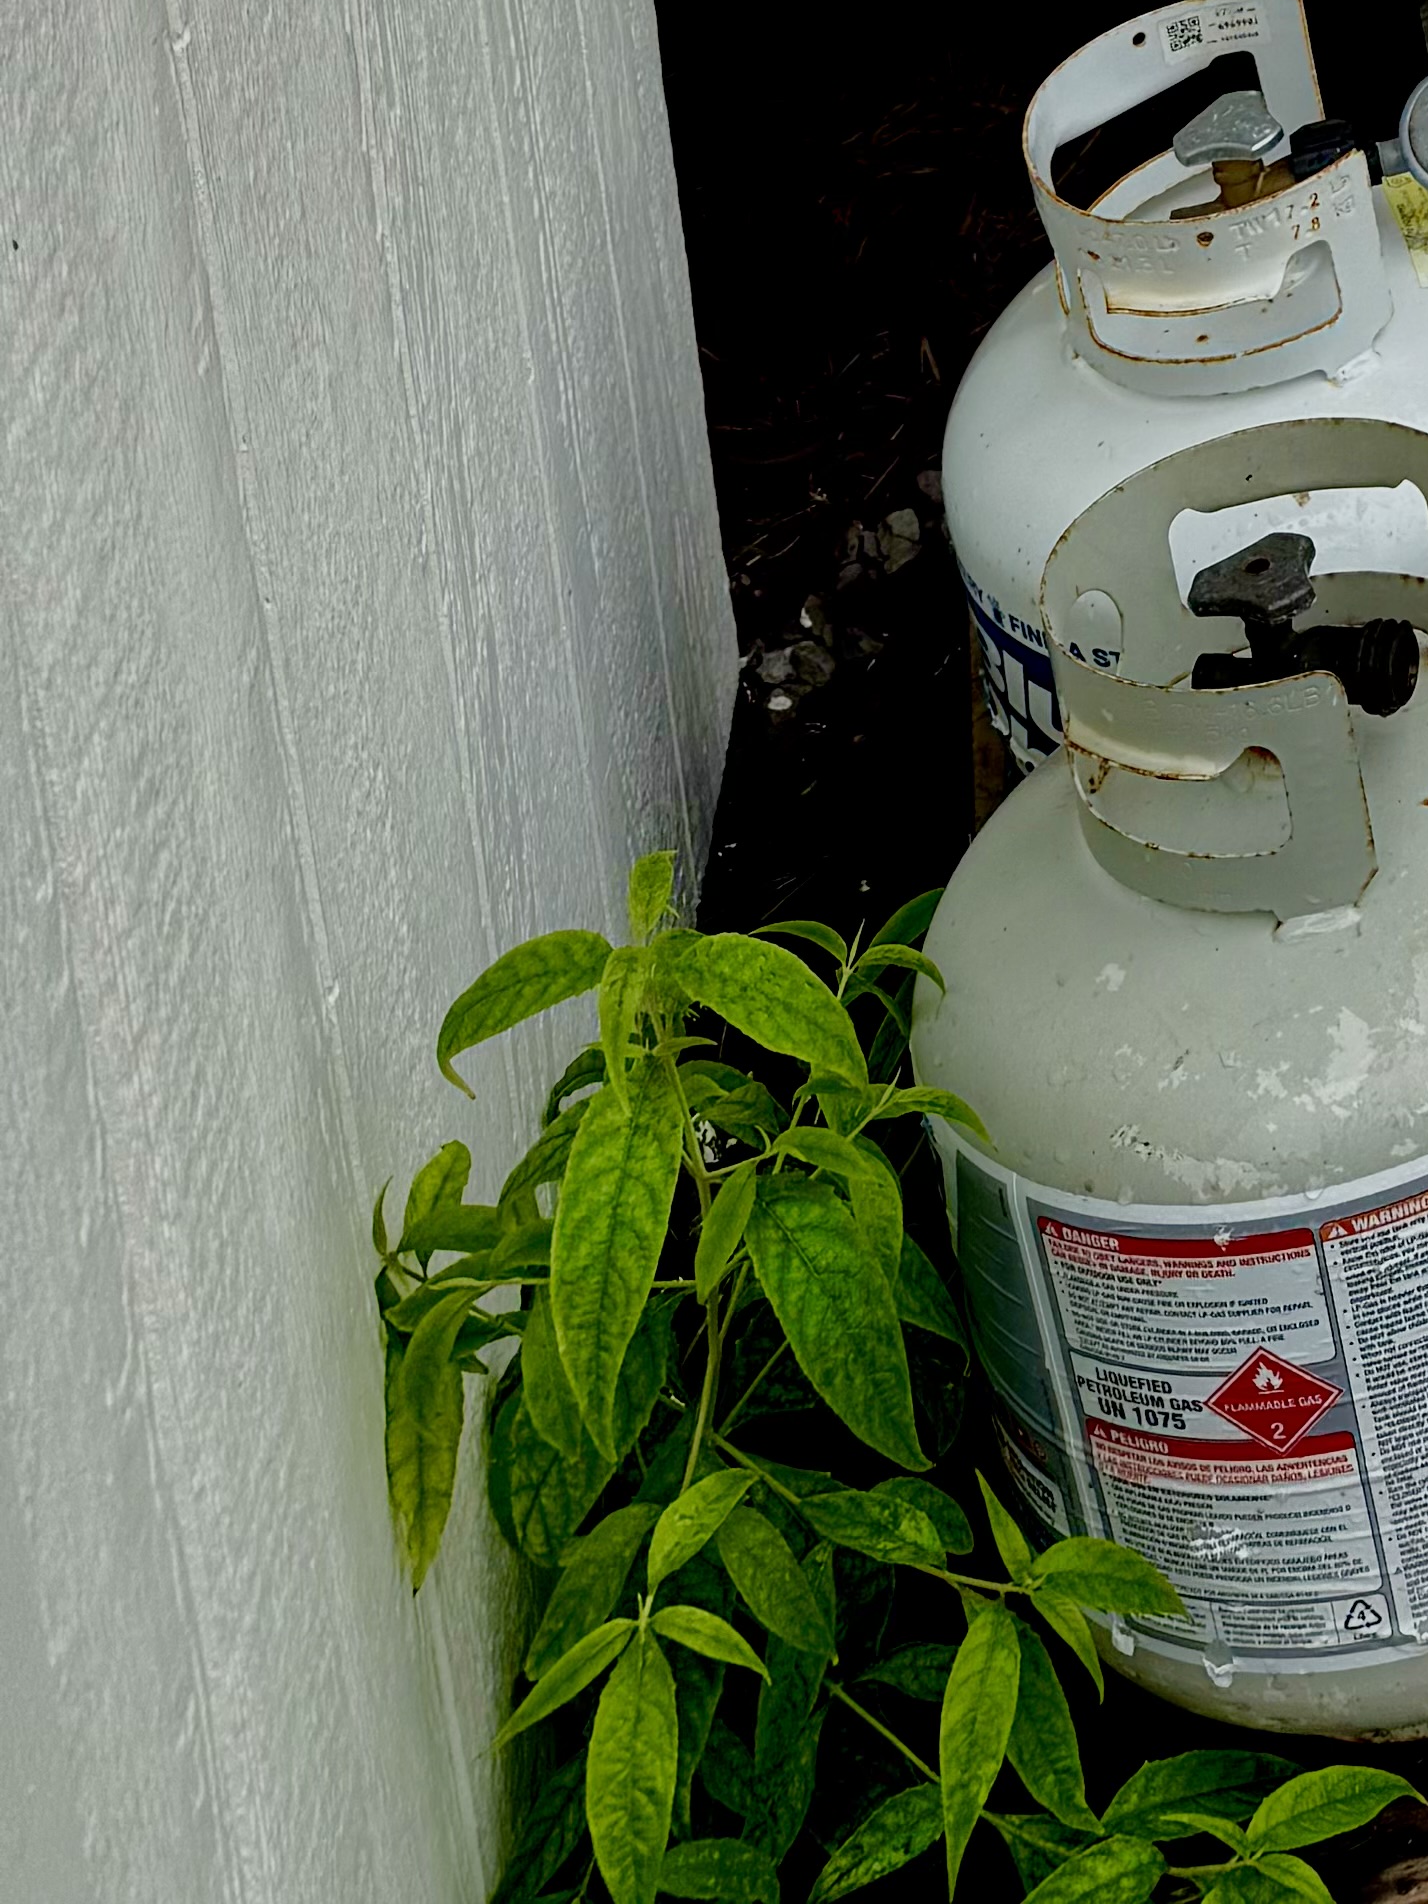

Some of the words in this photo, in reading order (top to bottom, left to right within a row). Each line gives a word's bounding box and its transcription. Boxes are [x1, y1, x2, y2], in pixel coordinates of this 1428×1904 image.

[1008, 614, 1047, 649] FIN
[1062, 1226, 1119, 1251] DANGER
[1077, 1375, 1165, 1409] PETROLEUM
[1170, 1399, 1204, 1413] GAS
[1095, 1367, 1173, 1395] LIQUEFIED
[1098, 1398, 1127, 1420] UN
[1134, 1407, 1186, 1431] 1075
[1223, 1398, 1296, 1412] FLAMMABLE
[1299, 1395, 1323, 1407] GAS
[1110, 1429, 1169, 1454] PELIGRO
[1270, 1422, 1287, 1440] 2
